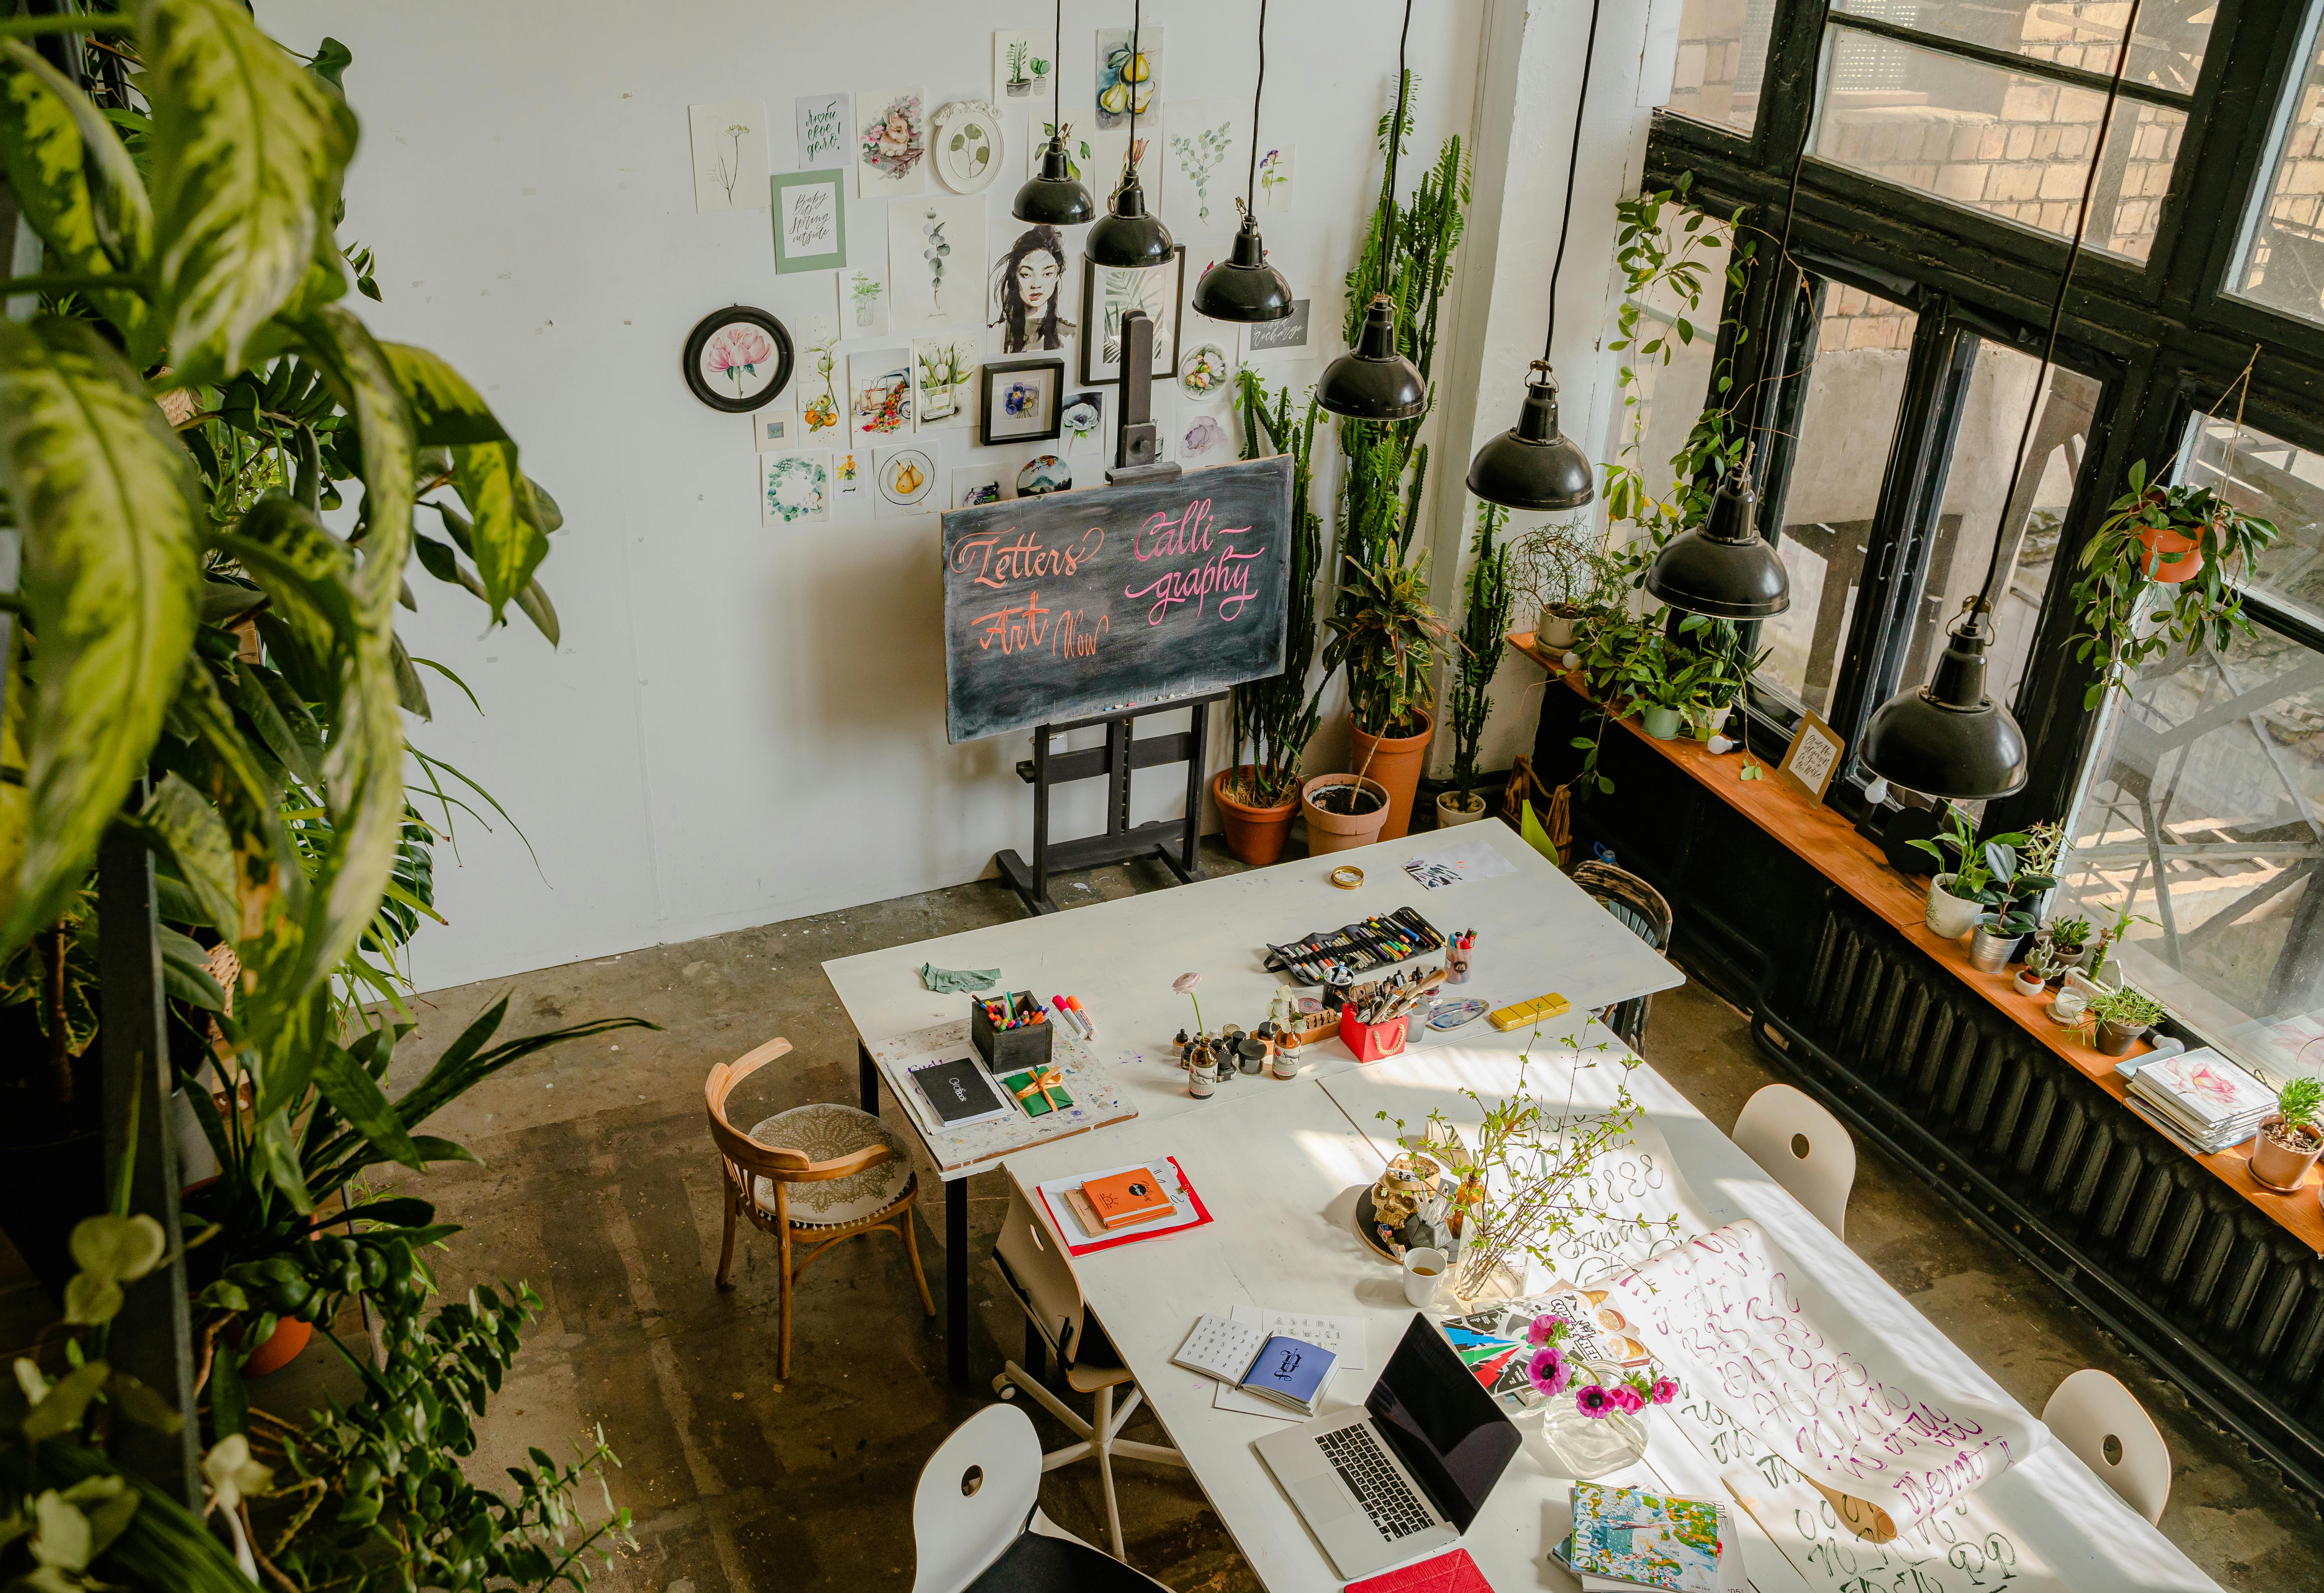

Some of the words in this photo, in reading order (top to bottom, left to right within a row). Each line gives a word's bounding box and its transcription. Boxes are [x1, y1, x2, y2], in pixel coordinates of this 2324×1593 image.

[793, 191, 829, 215] Baby
[792, 227, 830, 247] outside
[950, 526, 1105, 589] Letters
[1125, 545, 1265, 626] graphy
[971, 591, 1050, 656] Art
[1574, 1485, 1601, 1568] Seasons
